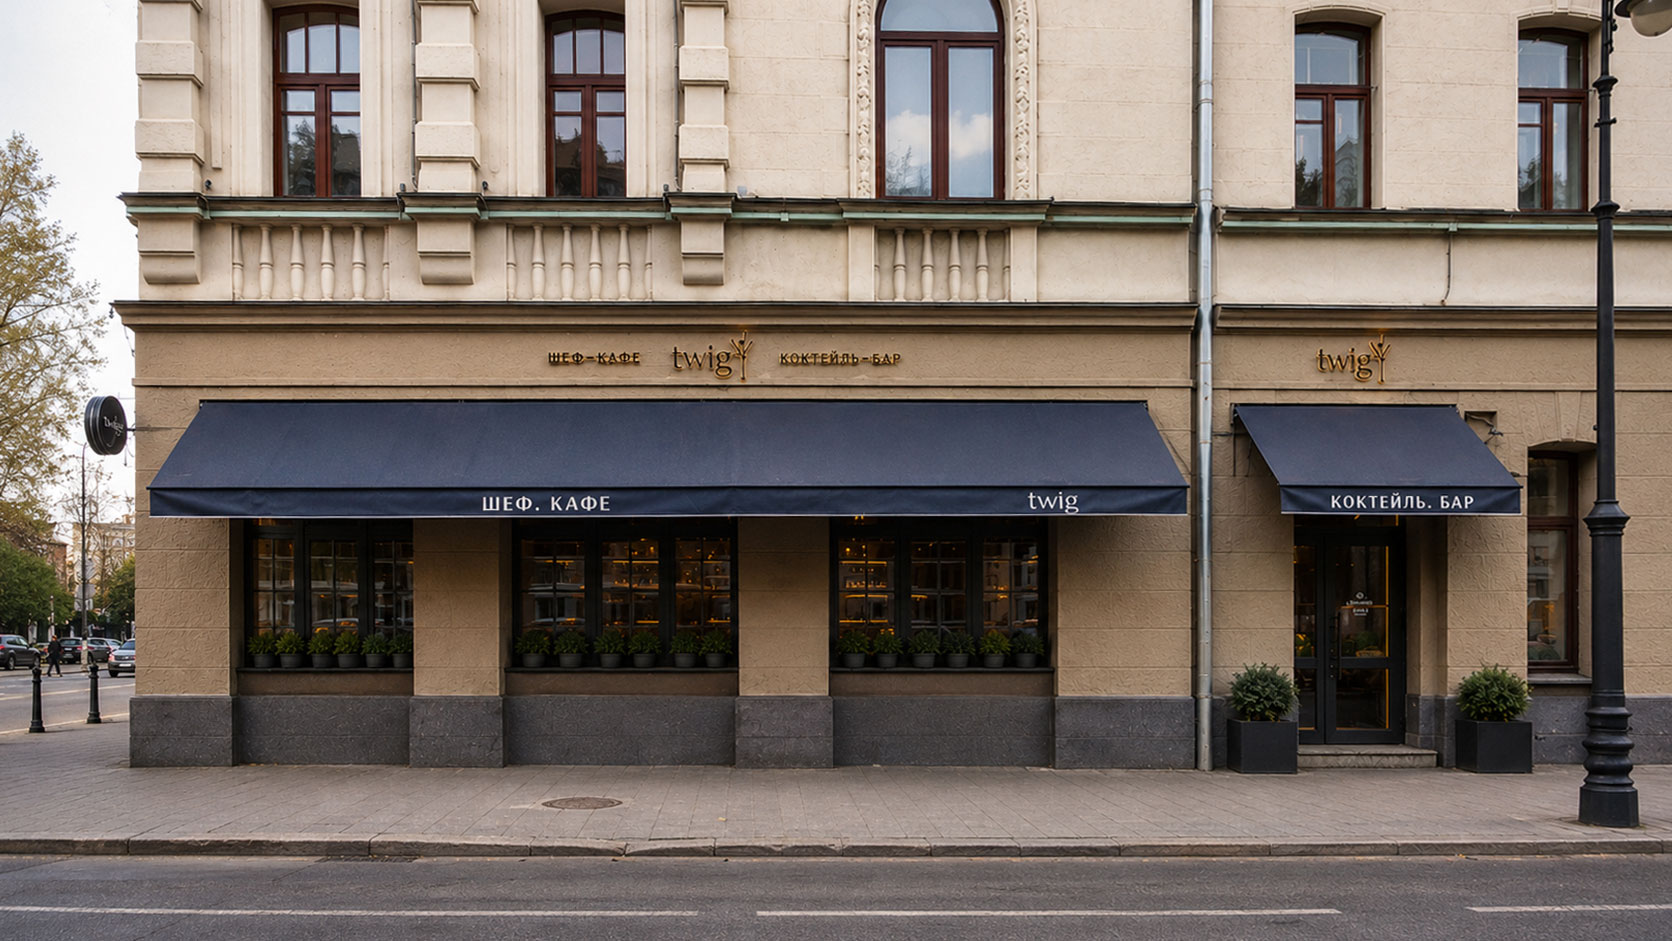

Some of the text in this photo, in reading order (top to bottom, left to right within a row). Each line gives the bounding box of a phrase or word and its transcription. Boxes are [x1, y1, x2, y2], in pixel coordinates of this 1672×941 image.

[548, 352, 640, 365] ШЕФ-КАФЕ
[672, 344, 732, 378] twig
[779, 350, 901, 366] КОКТЕЙЛЬ-БАР
[1316, 347, 1372, 381] twig
[482, 496, 610, 511] ШЕФ. КАФЕ
[1027, 491, 1079, 515] twig
[1331, 492, 1474, 509] КОКТЕЙЛЬ. БАР
